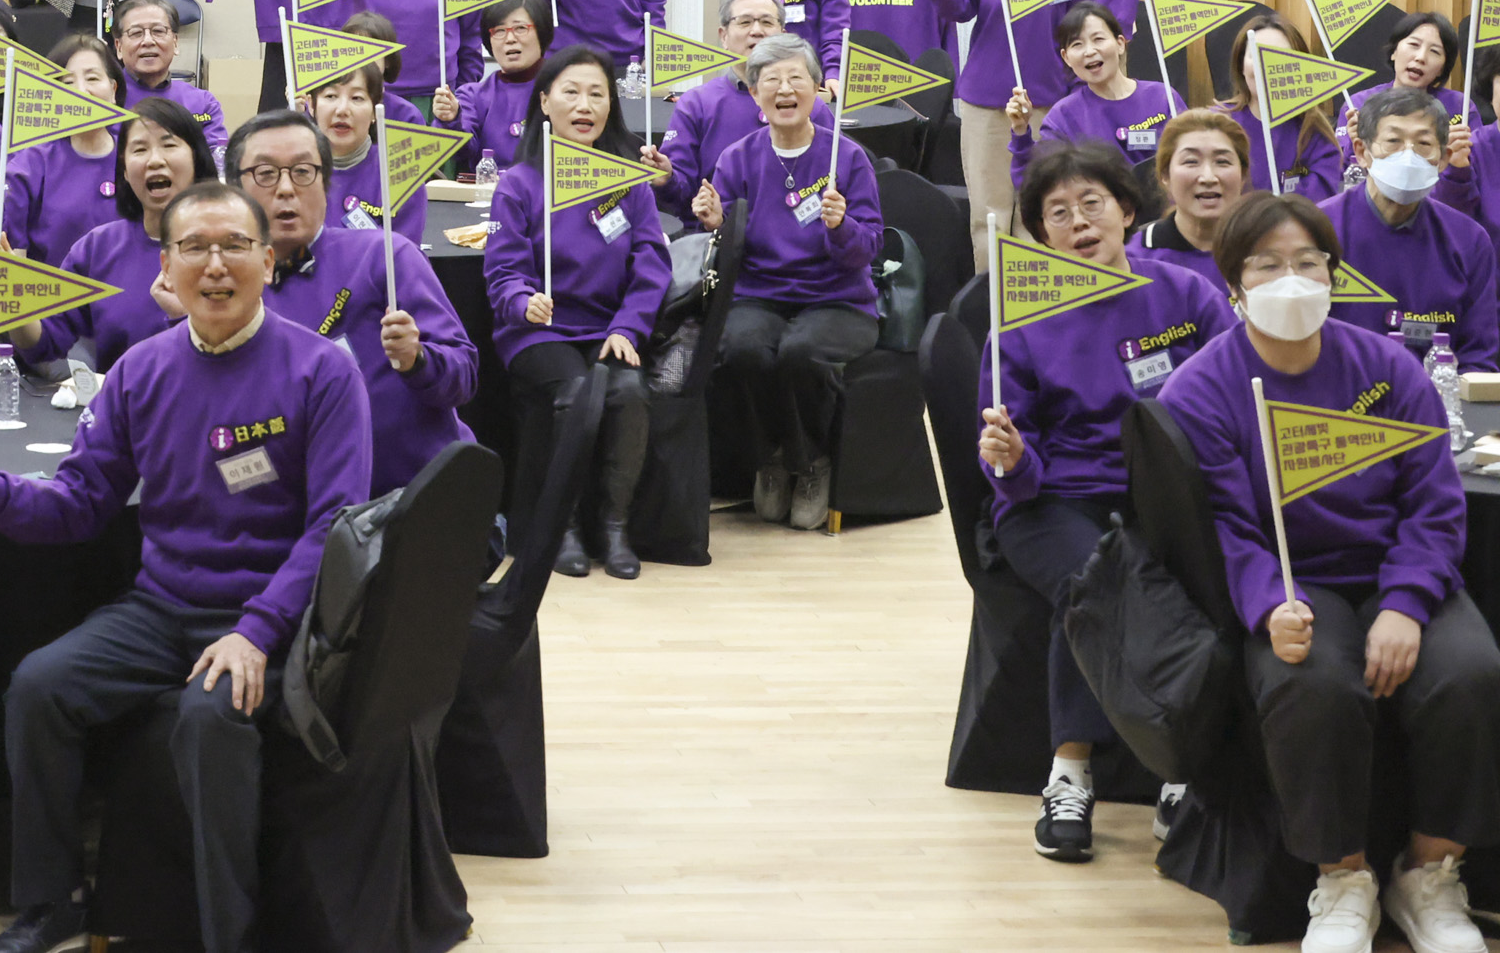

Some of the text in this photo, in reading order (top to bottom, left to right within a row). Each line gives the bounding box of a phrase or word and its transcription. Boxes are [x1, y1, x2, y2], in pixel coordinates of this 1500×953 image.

[1157, 3, 1187, 17] 고터세빛
[1159, 7, 1219, 27] 관광특구 통역안내
[1161, 22, 1198, 37] 자원봉사단
[295, 38, 328, 51] 고터세빛
[656, 44, 684, 52] 고터세빛
[296, 45, 364, 62] 관광특구 통역안내
[655, 53, 714, 62] 관광특구 통역안내
[297, 60, 339, 73] 자원봉사단
[655, 63, 691, 71] 자원봉사단
[851, 62, 881, 72] 고터세빛
[1267, 61, 1301, 76] 고터세빛
[849, 73, 912, 83] 관광특구 통역안내
[1269, 70, 1338, 88] 관광특구 통역안내
[17, 88, 53, 101] 고터세빛
[848, 84, 887, 93] 자원봉사단
[1271, 86, 1314, 101] 자원봉사단
[16, 101, 91, 117] 관광특구 통역안내
[15, 115, 61, 129] 자원봉사단
[1129, 113, 1166, 131] English
[556, 157, 589, 166] 고터세빛
[556, 168, 625, 177] 관광특구 통역안내
[556, 180, 598, 189] 자원봉사단
[1005, 260, 1049, 273] 고터세빛
[1006, 274, 1097, 288] 관광특구 통역안내
[12, 283, 61, 297] 통역안내
[1006, 290, 1061, 303] 자원봉사단
[319, 289, 350, 334] ançais
[1139, 322, 1197, 350] English
[1352, 382, 1390, 415] glish
[1279, 422, 1330, 441] 고터세빛
[1281, 430, 1386, 456] 관광특구 통역안내
[1283, 451, 1347, 472] 자원봉사단
